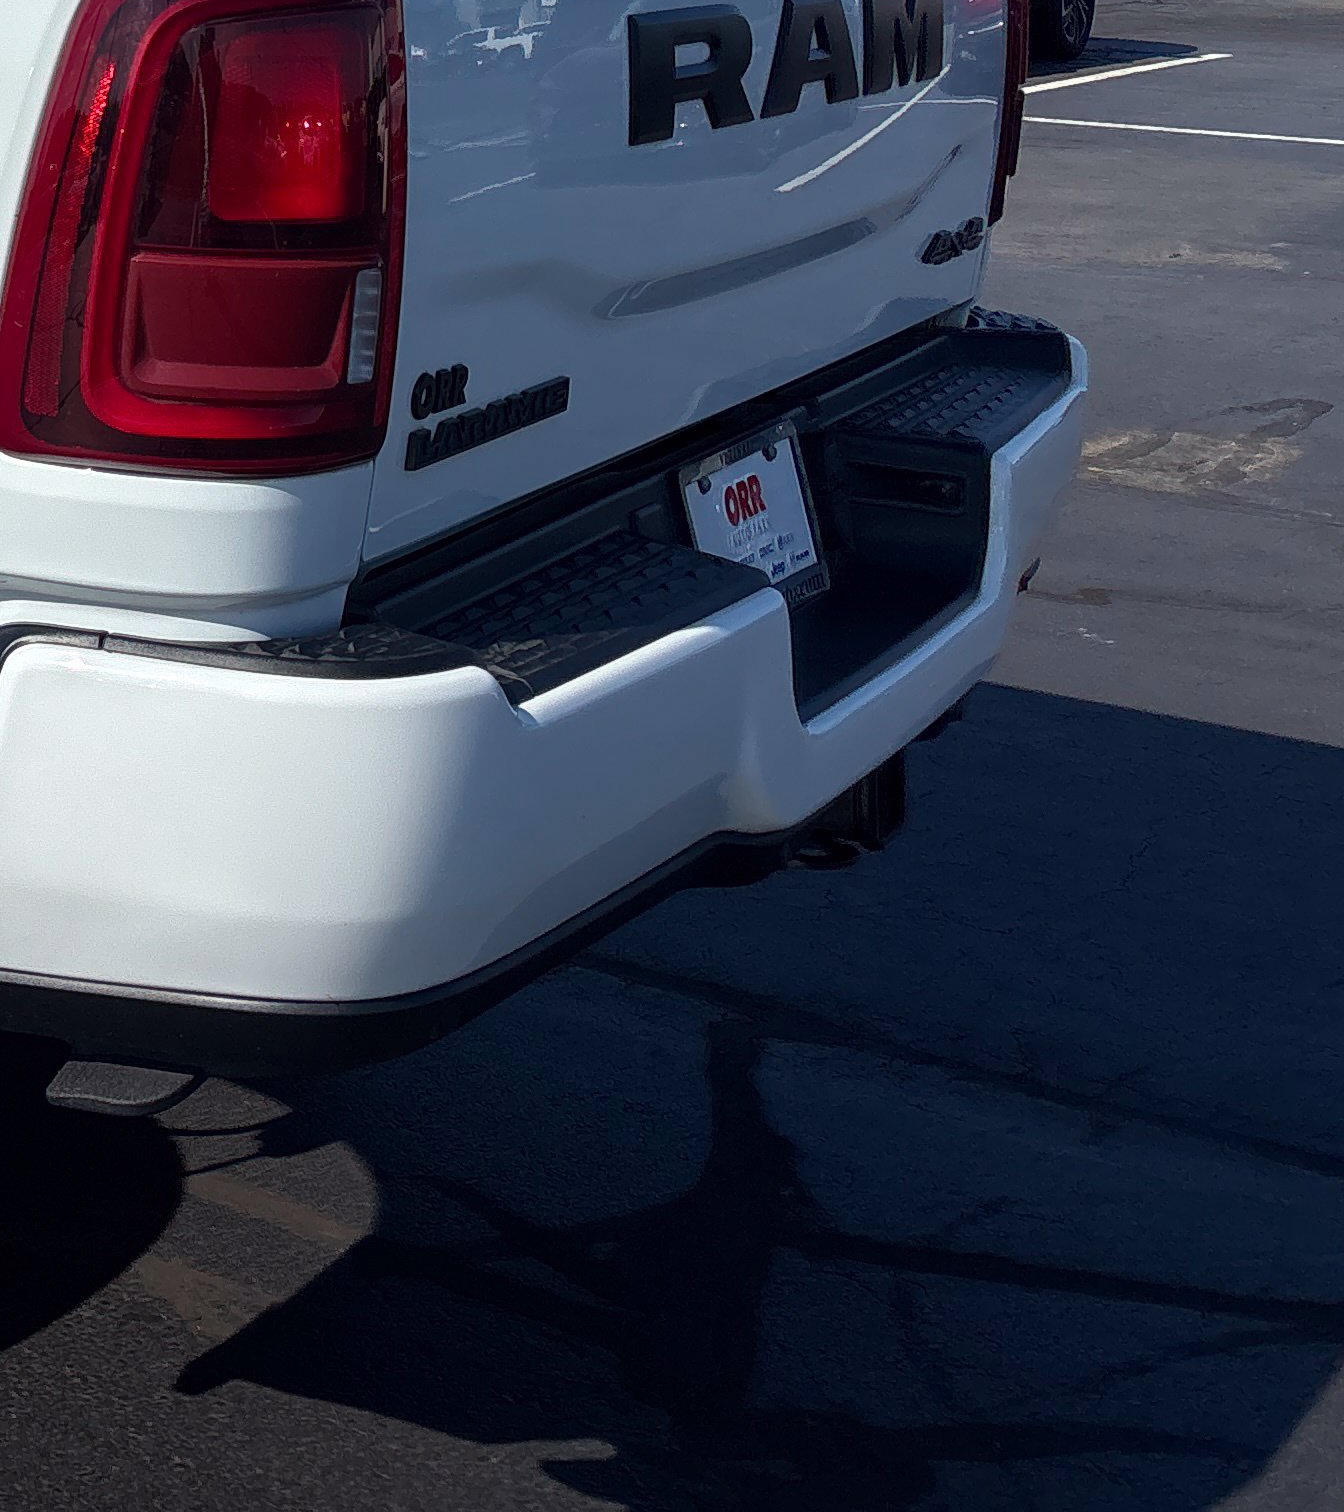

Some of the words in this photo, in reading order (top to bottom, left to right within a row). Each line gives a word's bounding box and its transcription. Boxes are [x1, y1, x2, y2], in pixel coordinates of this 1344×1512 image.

[411, 364, 469, 420] ORR
[405, 376, 571, 472] LARAMIE
[724, 474, 767, 527] ORR
